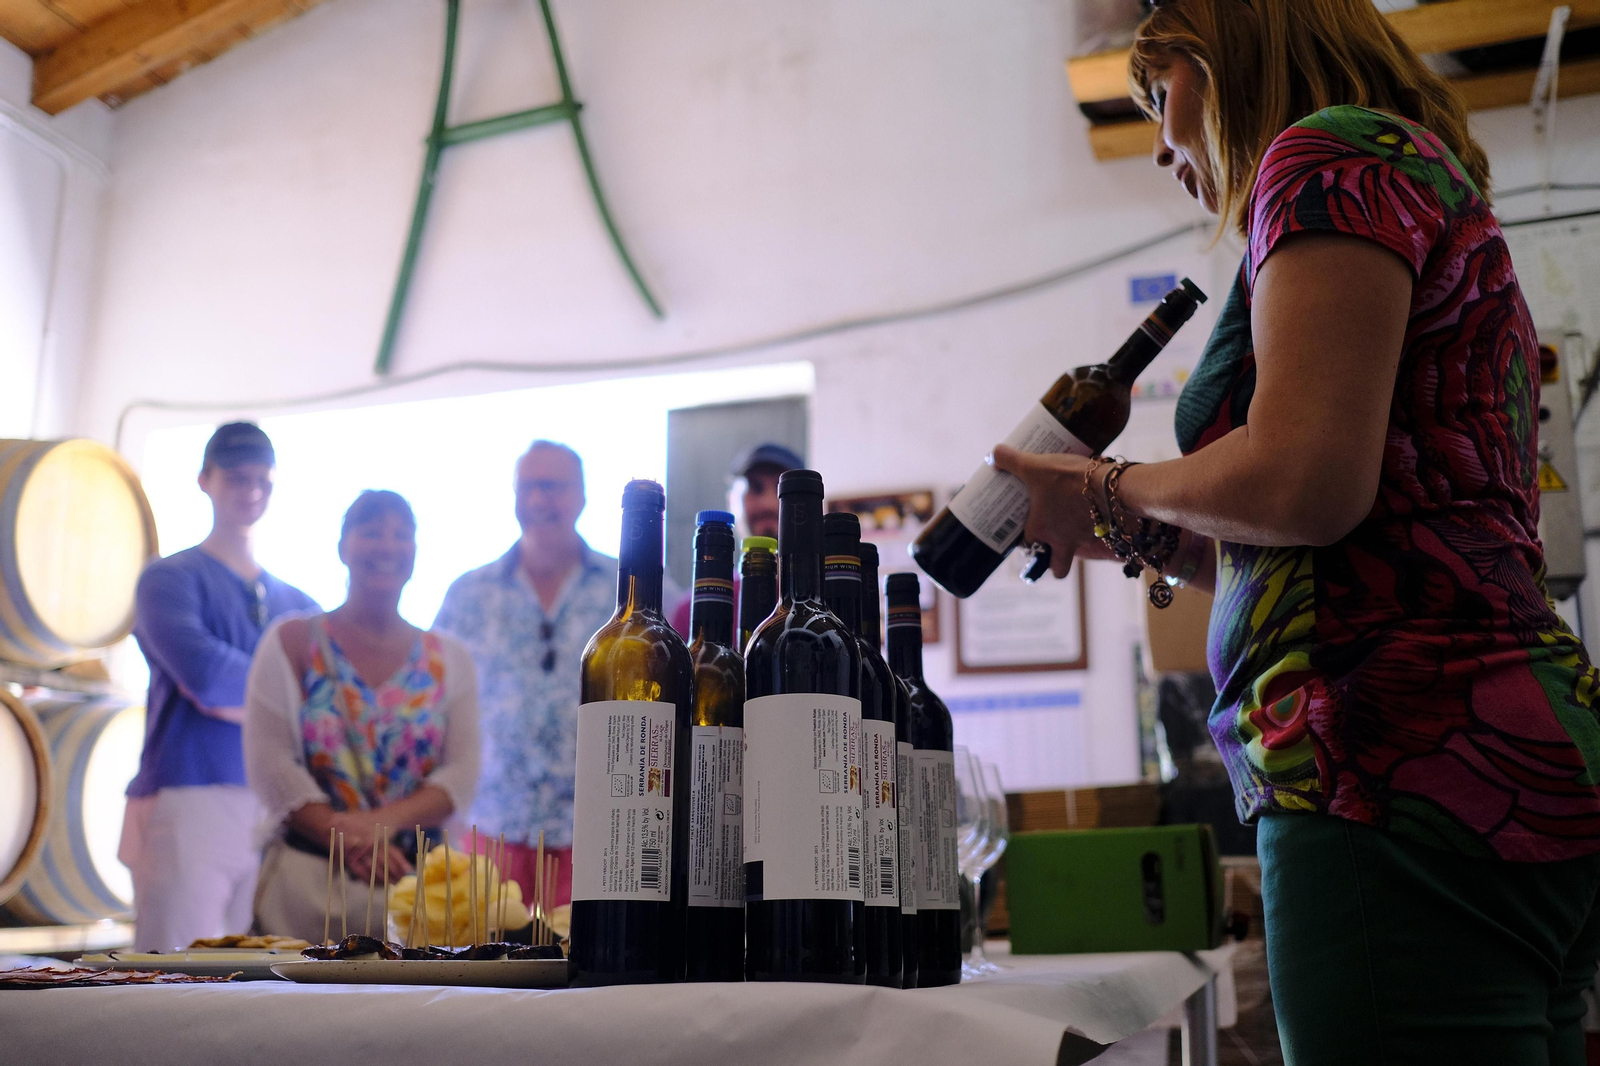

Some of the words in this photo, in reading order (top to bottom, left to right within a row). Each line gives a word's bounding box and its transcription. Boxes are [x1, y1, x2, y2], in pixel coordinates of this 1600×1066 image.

[640, 746, 646, 755] DE
[651, 729, 659, 767] SIERRAS
[843, 741, 848, 752] DE
[874, 761, 880, 770] DE
[649, 838, 657, 848] 750
